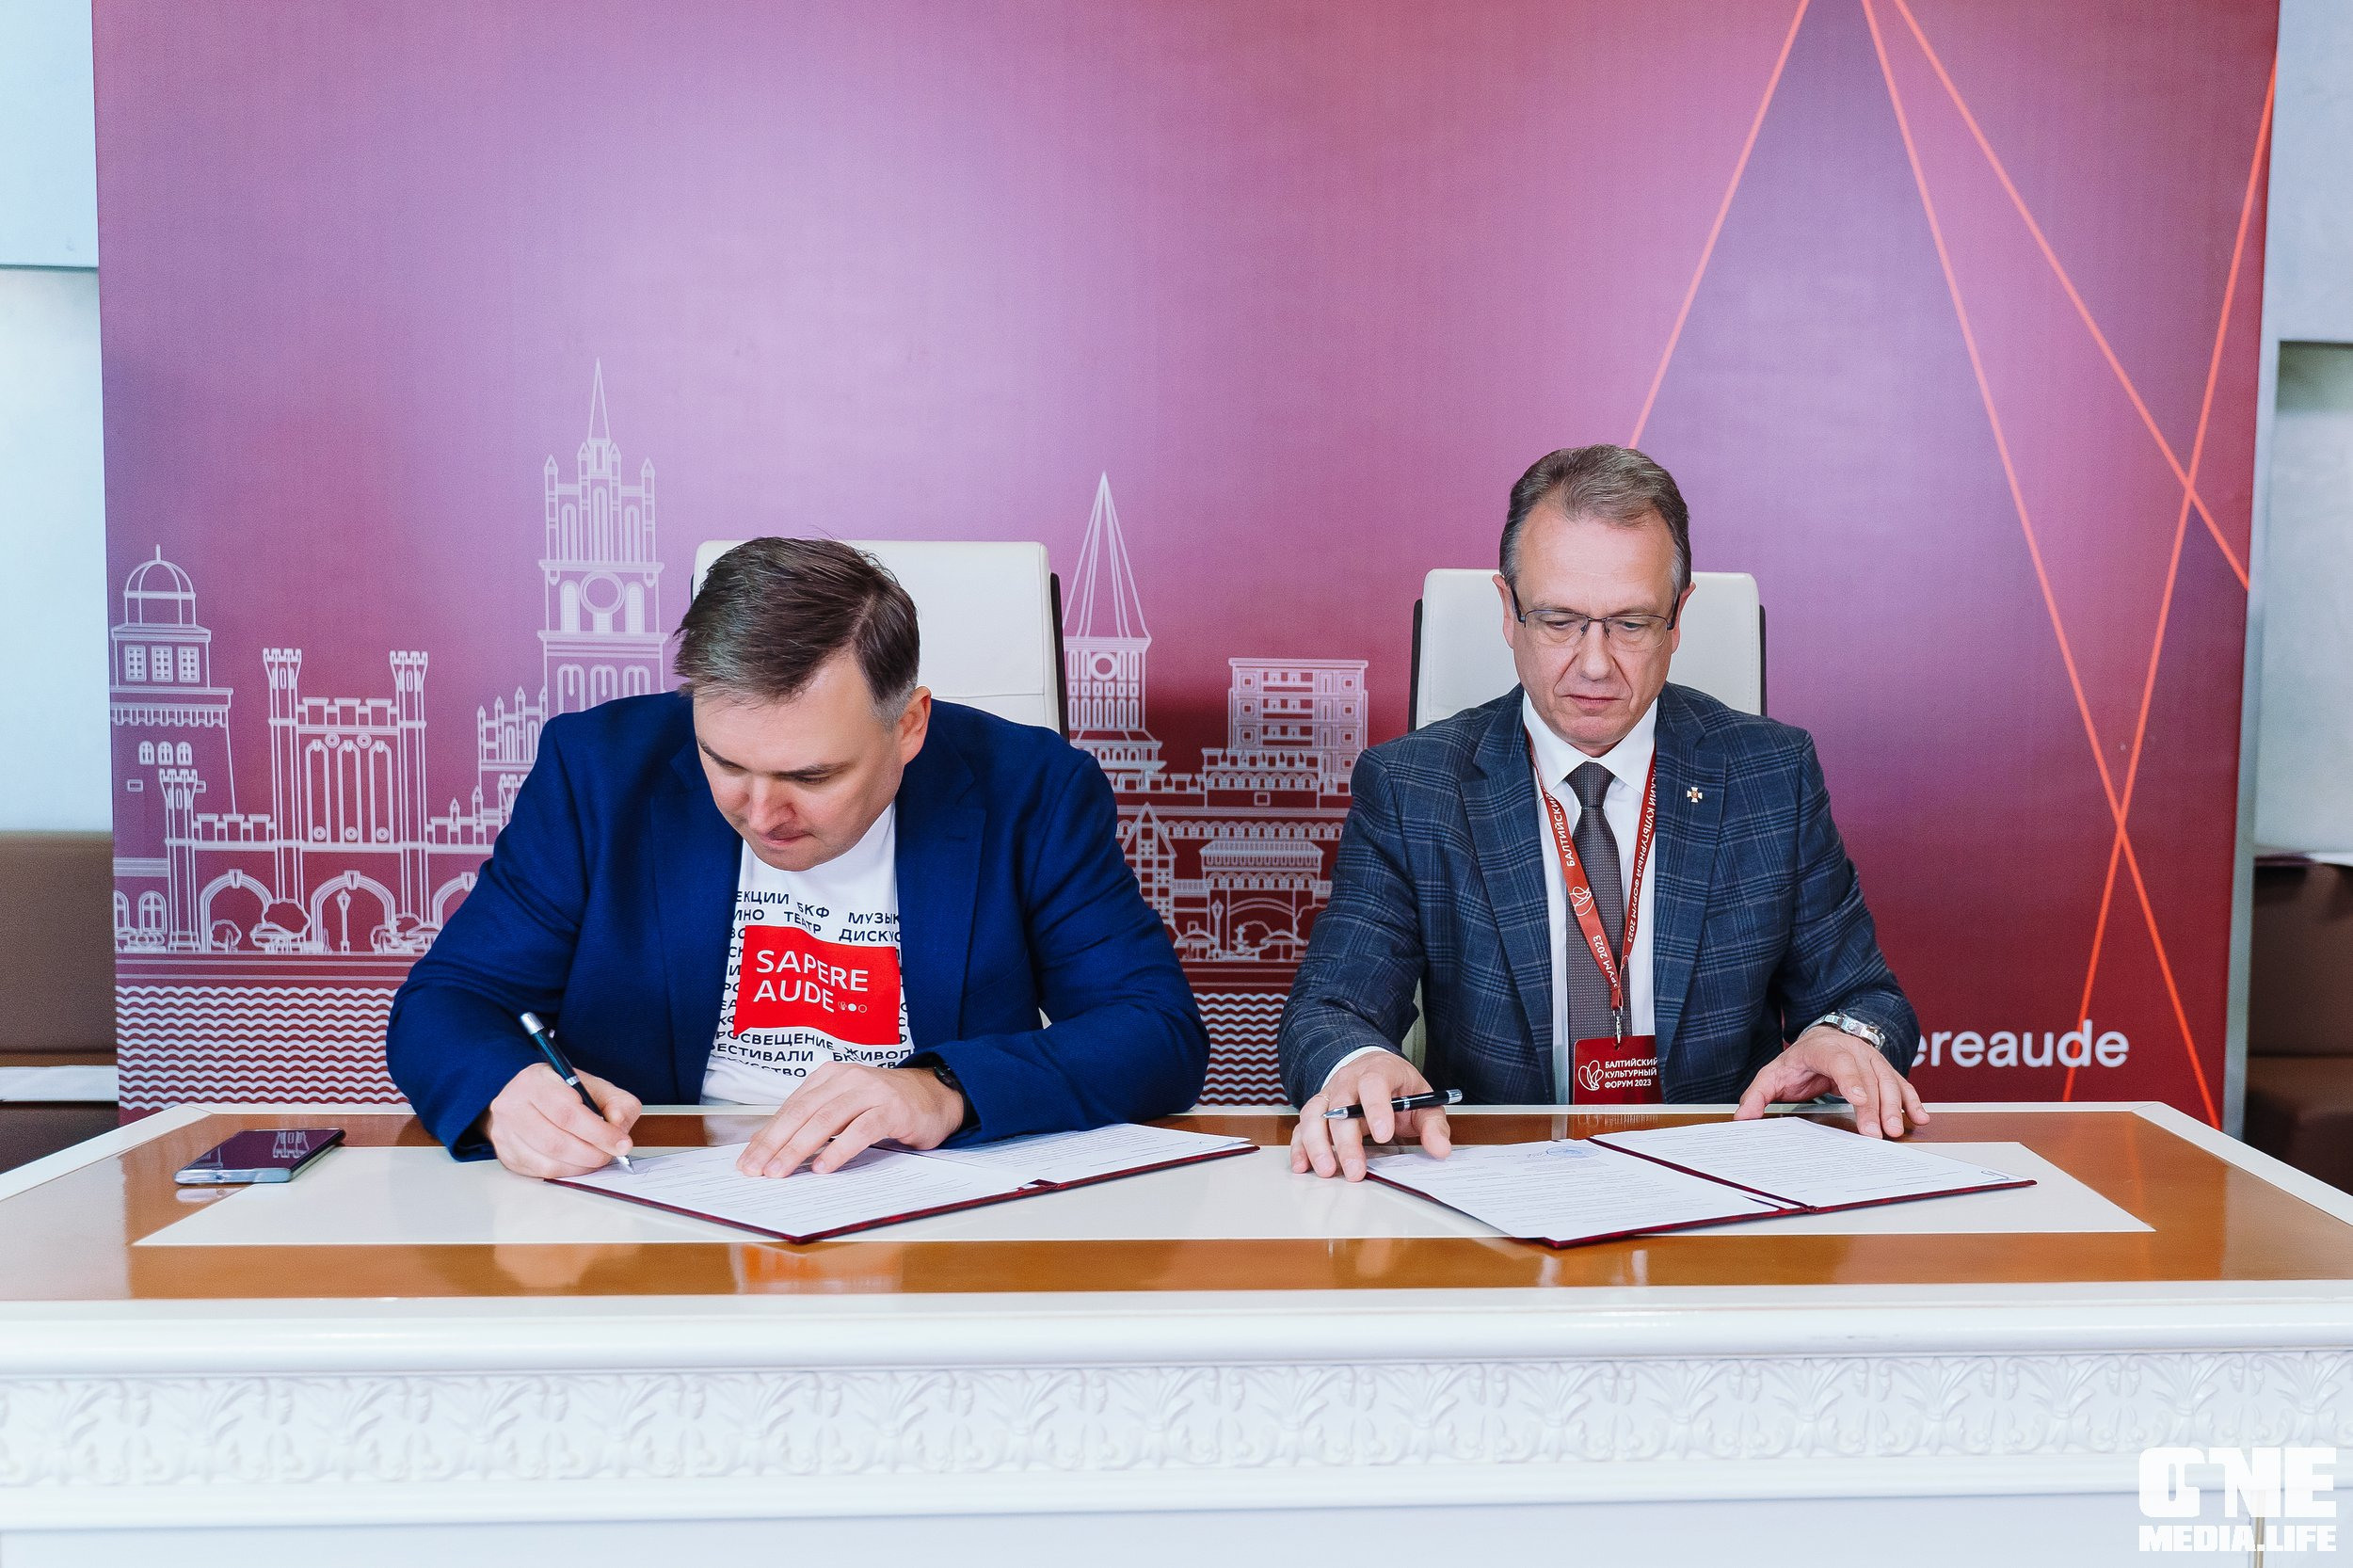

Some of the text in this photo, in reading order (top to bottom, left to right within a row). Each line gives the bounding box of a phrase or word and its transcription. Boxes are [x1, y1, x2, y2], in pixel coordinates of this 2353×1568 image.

[1636, 807, 1656, 878] КУЛЬТУРНЫЙ
[1630, 878, 1640, 919] ФОРУМ
[796, 902, 830, 919] БКФ
[784, 911, 822, 935] ТЕАТР
[1627, 920, 1636, 943] 2023
[1593, 935, 1609, 959] 2023
[756, 950, 869, 992] SAPERE
[753, 980, 835, 1013] AUDE
[711, 1043, 813, 1062] ЕСТИВАЛИ
[1605, 1057, 1657, 1069] БАЛТИЙСКИЙ
[1604, 1079, 1652, 1089] ФОРУМ 2023
[1605, 1067, 1657, 1079] КУЛЬТУРНЫЙ
